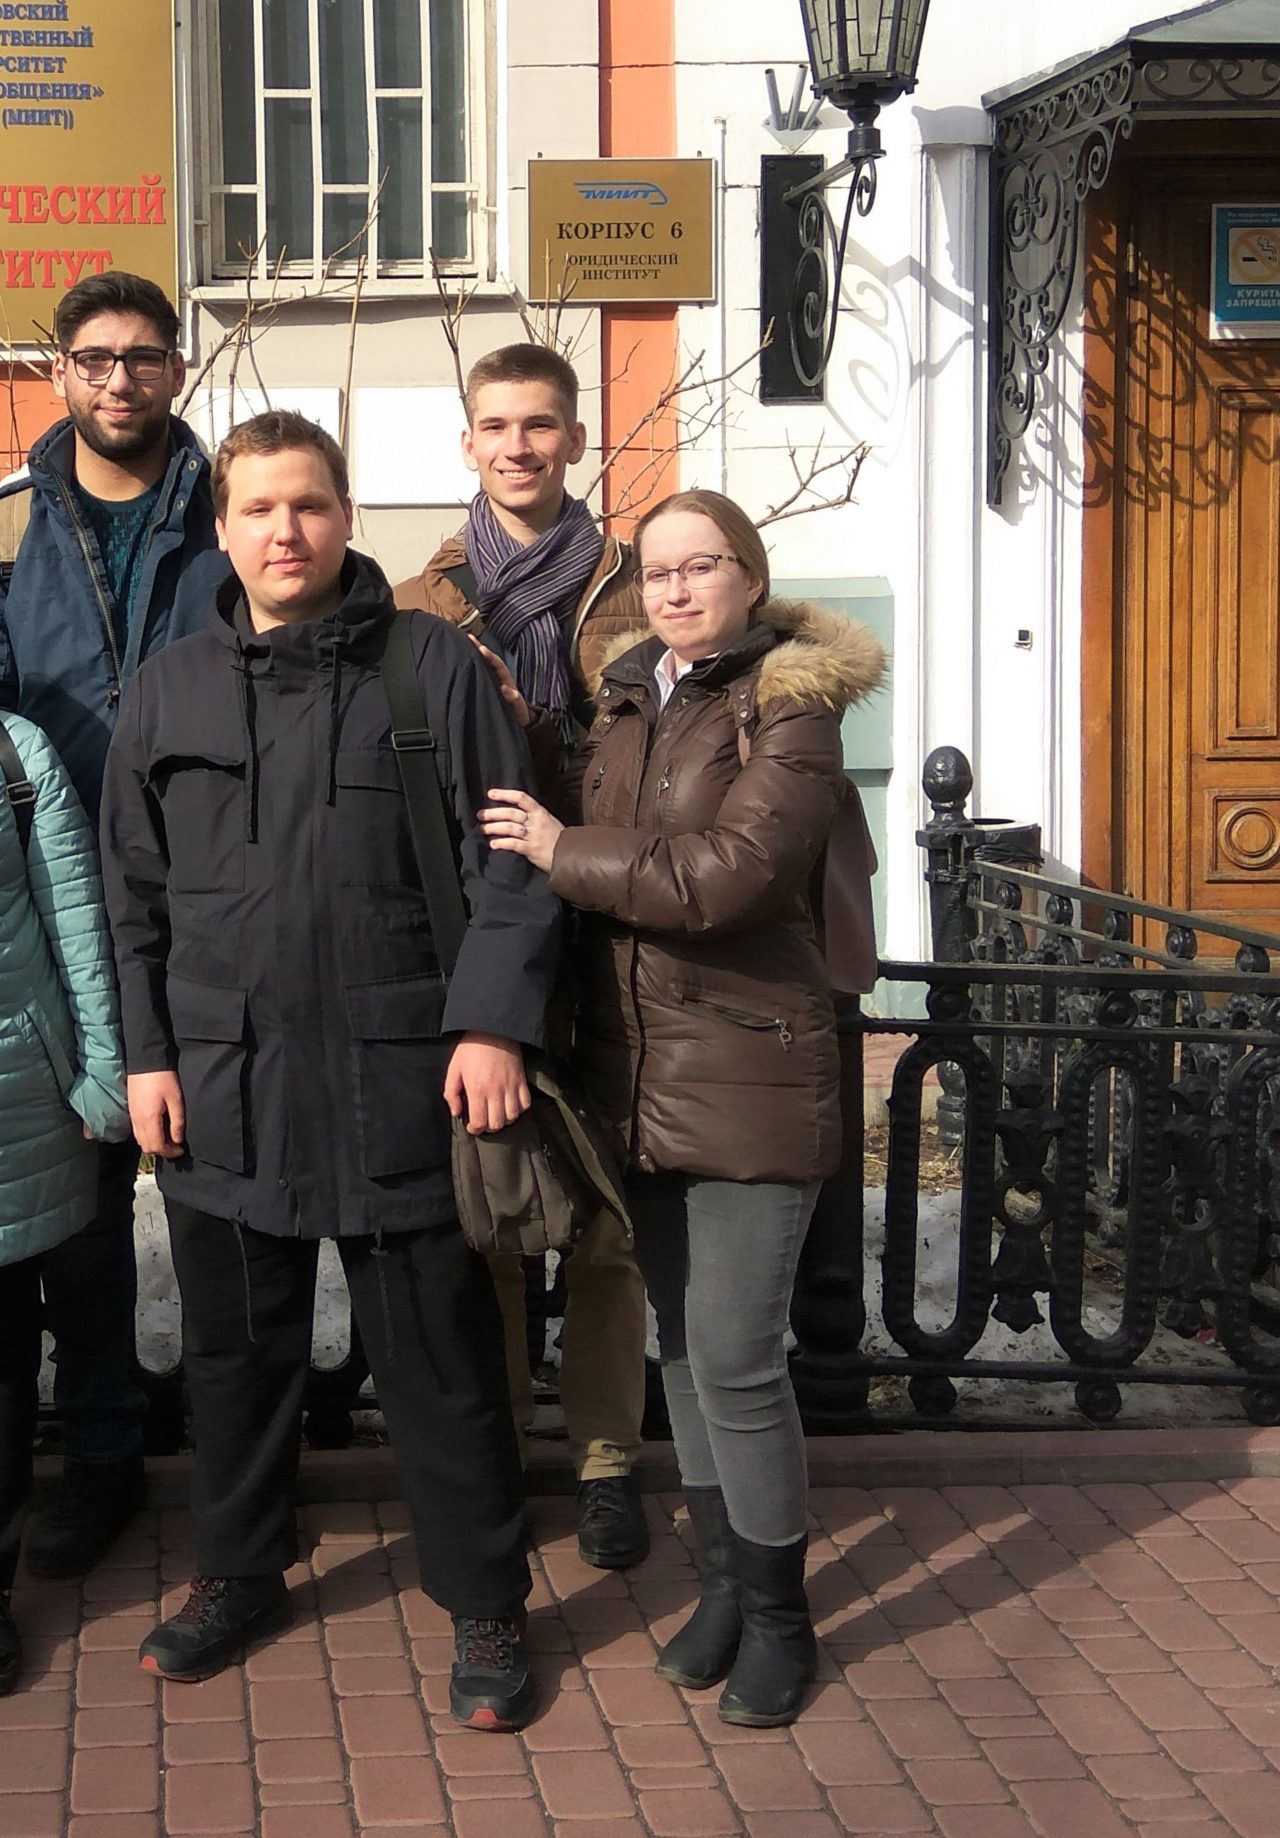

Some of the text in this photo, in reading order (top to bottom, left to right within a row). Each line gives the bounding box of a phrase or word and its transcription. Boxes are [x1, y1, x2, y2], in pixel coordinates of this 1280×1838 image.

[2, 108, 74, 130] (МИИТ))
[556, 221, 683, 240] КОРПУС 6
[582, 269, 661, 280] ИНСТИТУТ
[1237, 289, 1280, 298] КУРИТЬ
